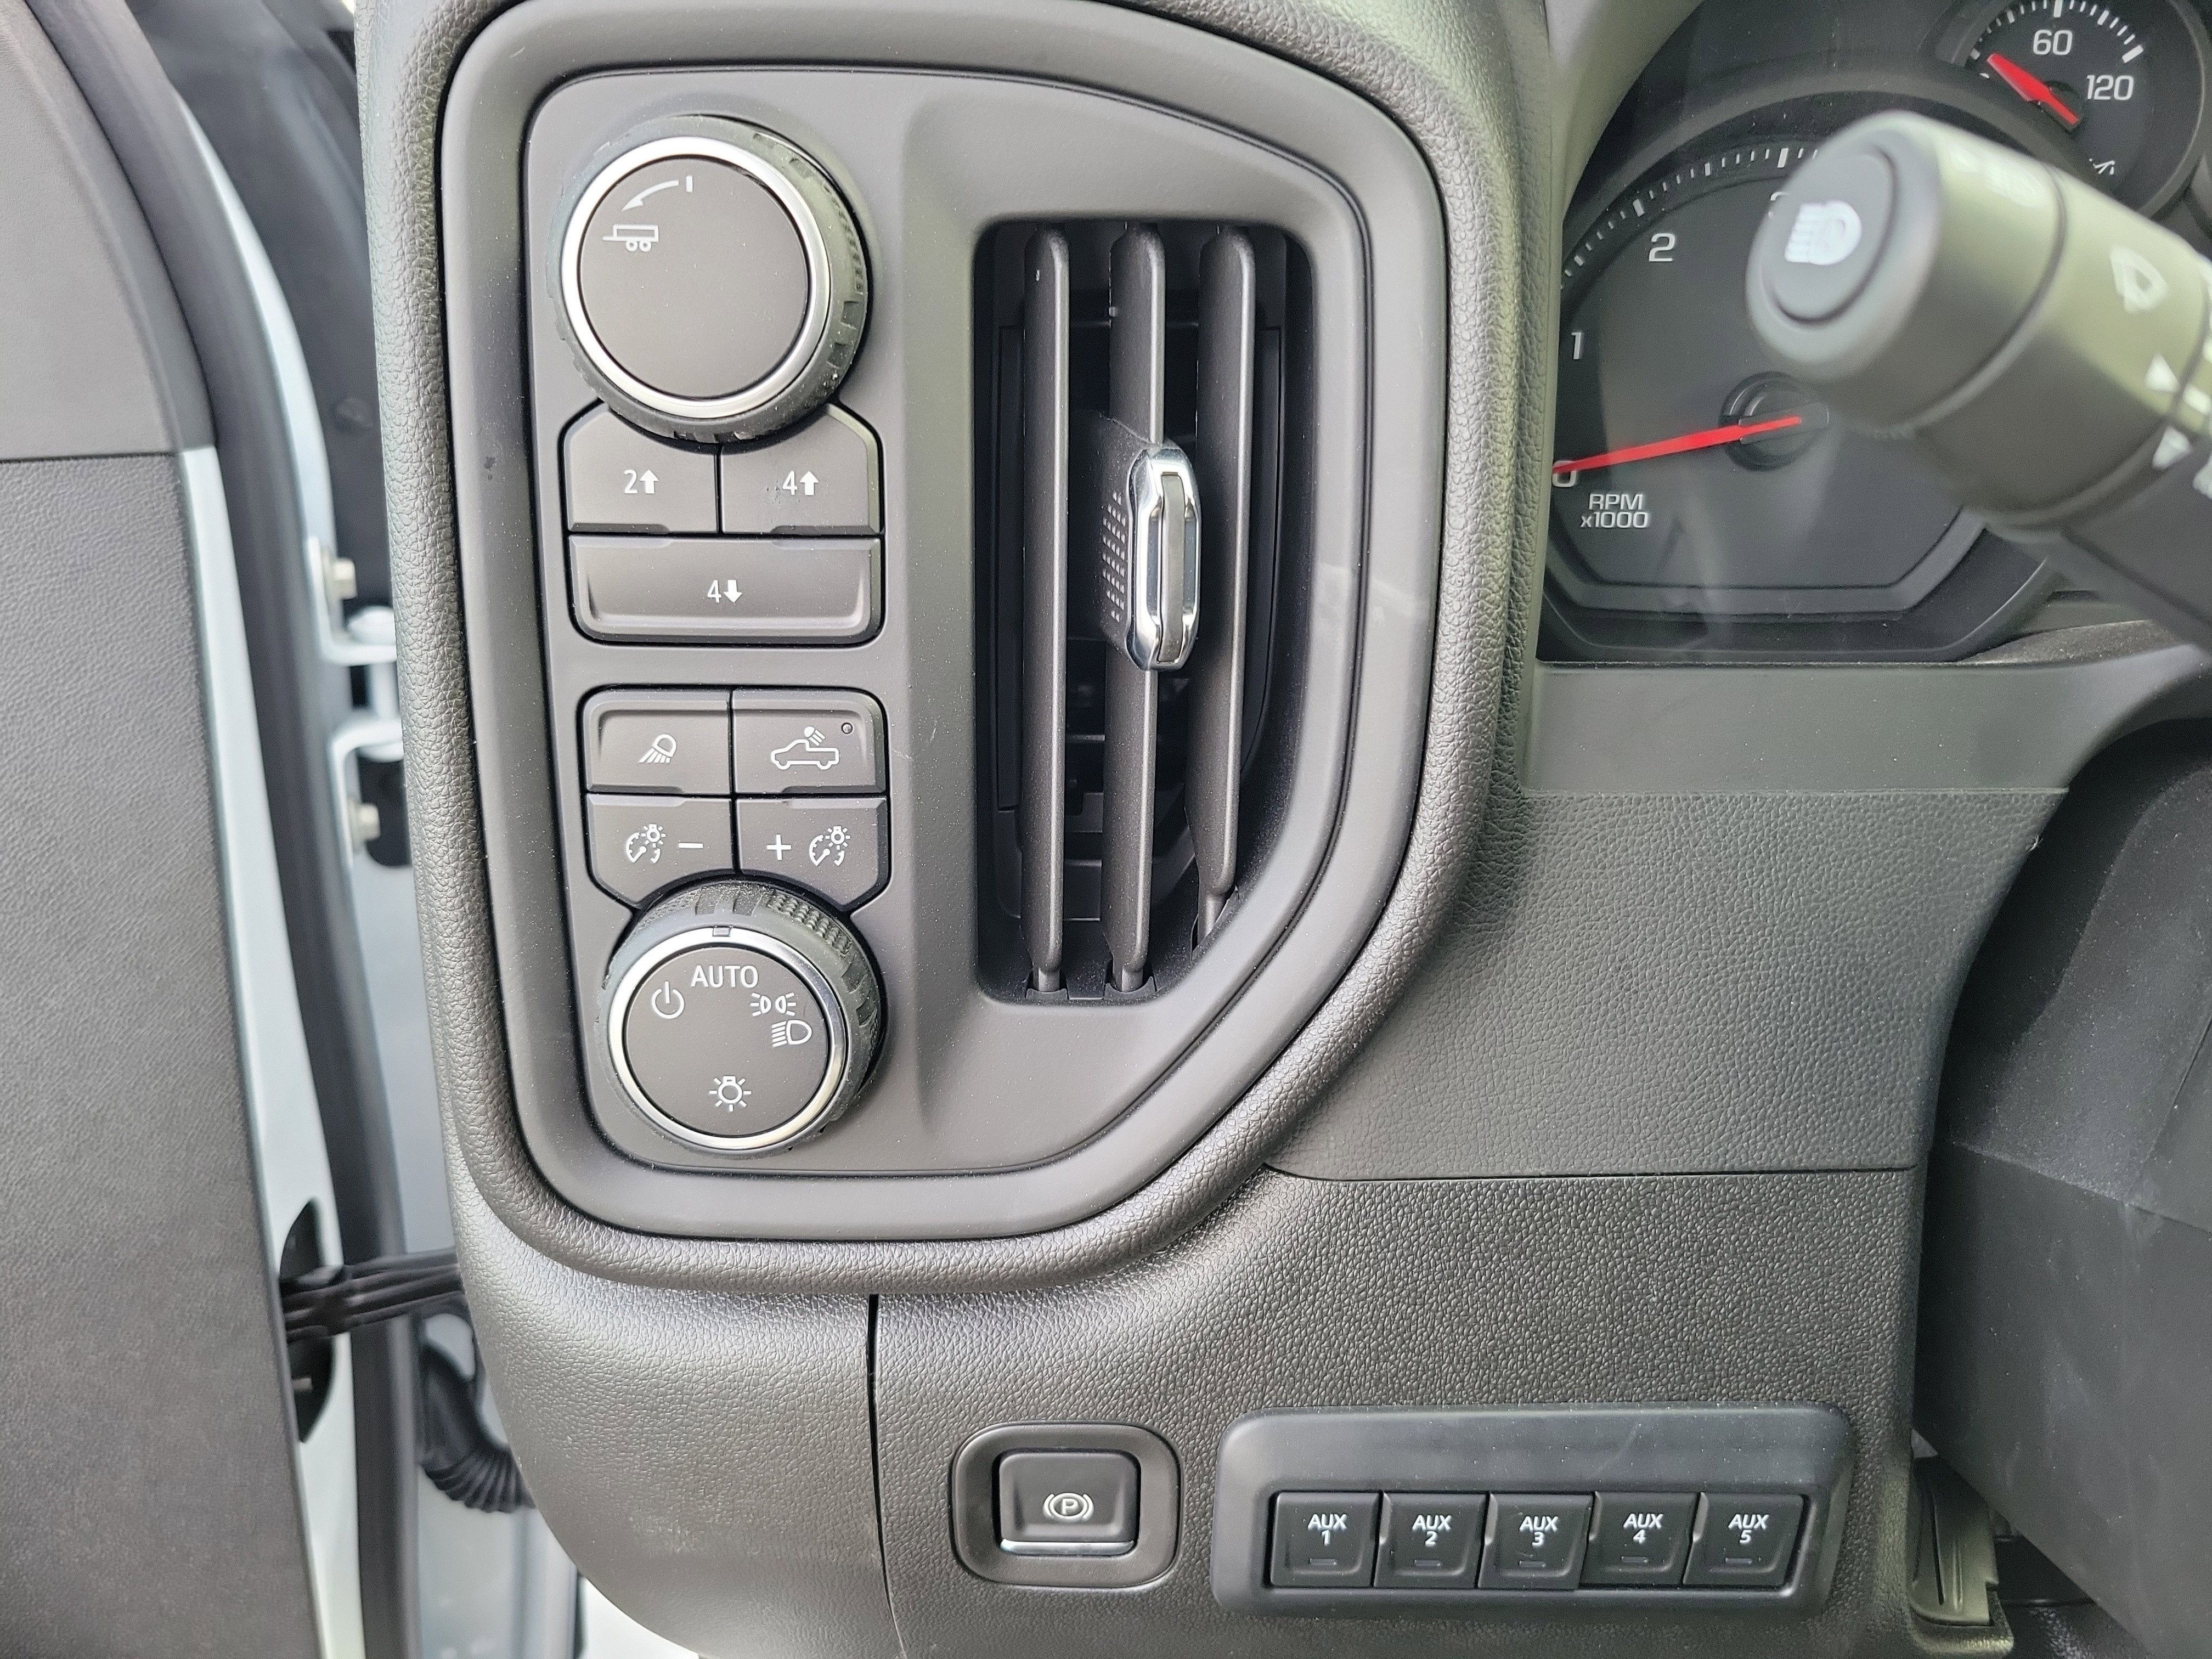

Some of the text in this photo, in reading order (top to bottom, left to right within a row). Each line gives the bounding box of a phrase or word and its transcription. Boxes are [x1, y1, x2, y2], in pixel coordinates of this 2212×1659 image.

[2033, 30, 2073, 55] 60
[2086, 75, 2134, 101] 120
[1648, 233, 1676, 262] 2
[1570, 331, 1583, 360] 1
[624, 470, 638, 494] 2
[782, 471, 798, 495] 4
[1589, 493, 1644, 510] RPM
[1580, 511, 1649, 528] x1000
[707, 580, 722, 603] 4
[691, 965, 759, 988] AUTO
[1308, 1514, 1347, 1529] AUX
[1412, 1515, 1451, 1531] AUX
[1519, 1516, 1558, 1532] AUX
[1623, 1513, 1663, 1528] AUX
[1728, 1514, 1770, 1529] AUX
[1321, 1530, 1331, 1545] 1
[1425, 1531, 1437, 1546] 2
[1532, 1532, 1544, 1547] 3
[1633, 1530, 1646, 1543] 4
[1739, 1530, 1751, 1544] 5
